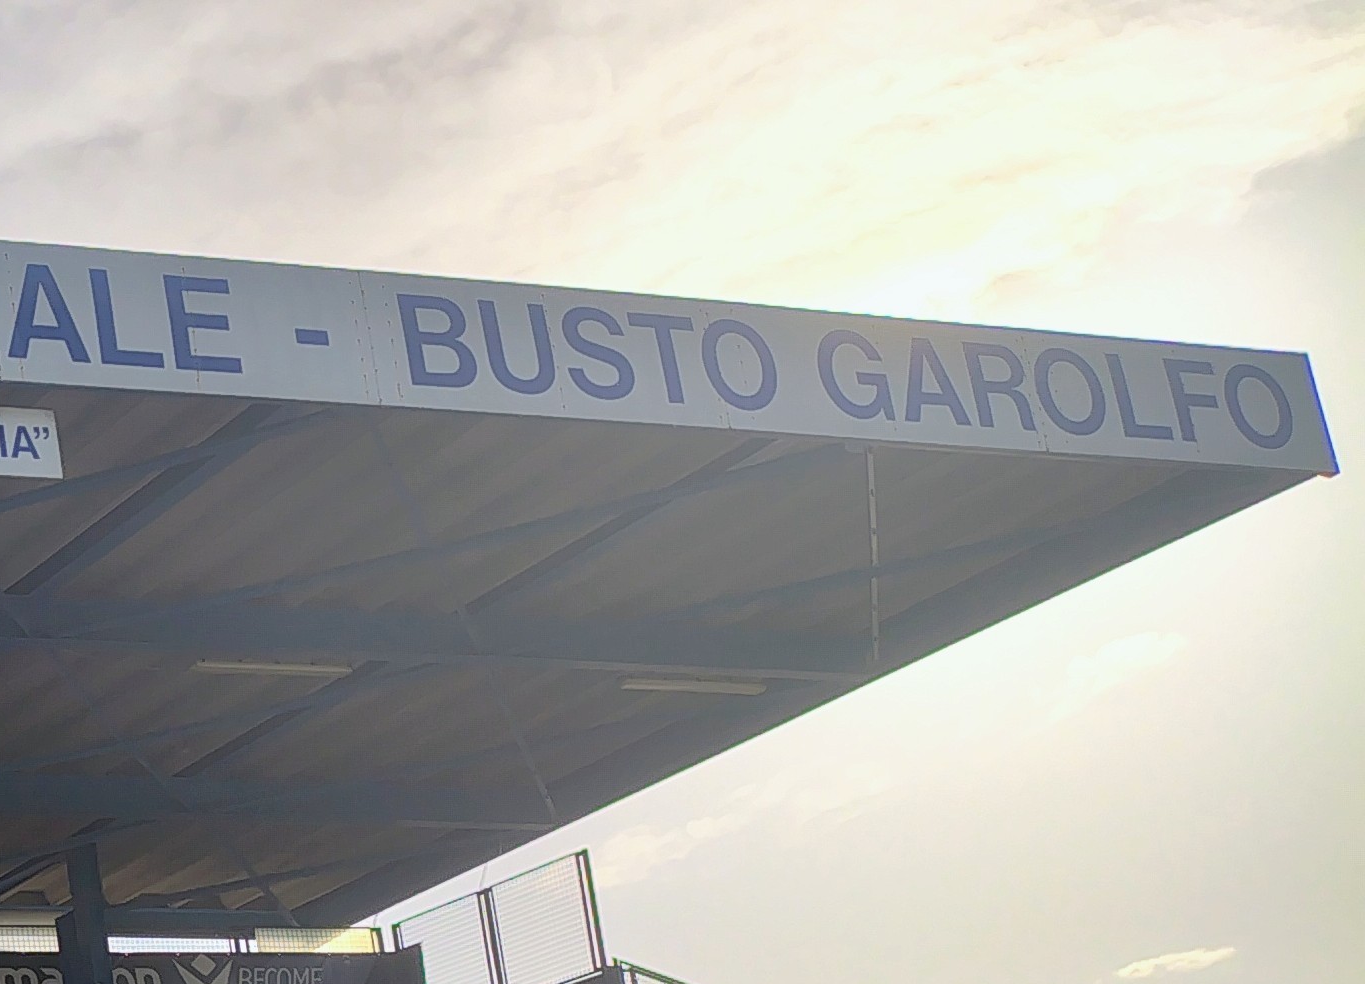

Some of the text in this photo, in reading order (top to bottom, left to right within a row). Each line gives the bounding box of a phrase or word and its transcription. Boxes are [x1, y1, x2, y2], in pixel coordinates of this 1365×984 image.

[294, 327, 330, 347] -
[396, 292, 778, 412] BUSTO
[816, 329, 1293, 450] GAROLFO
